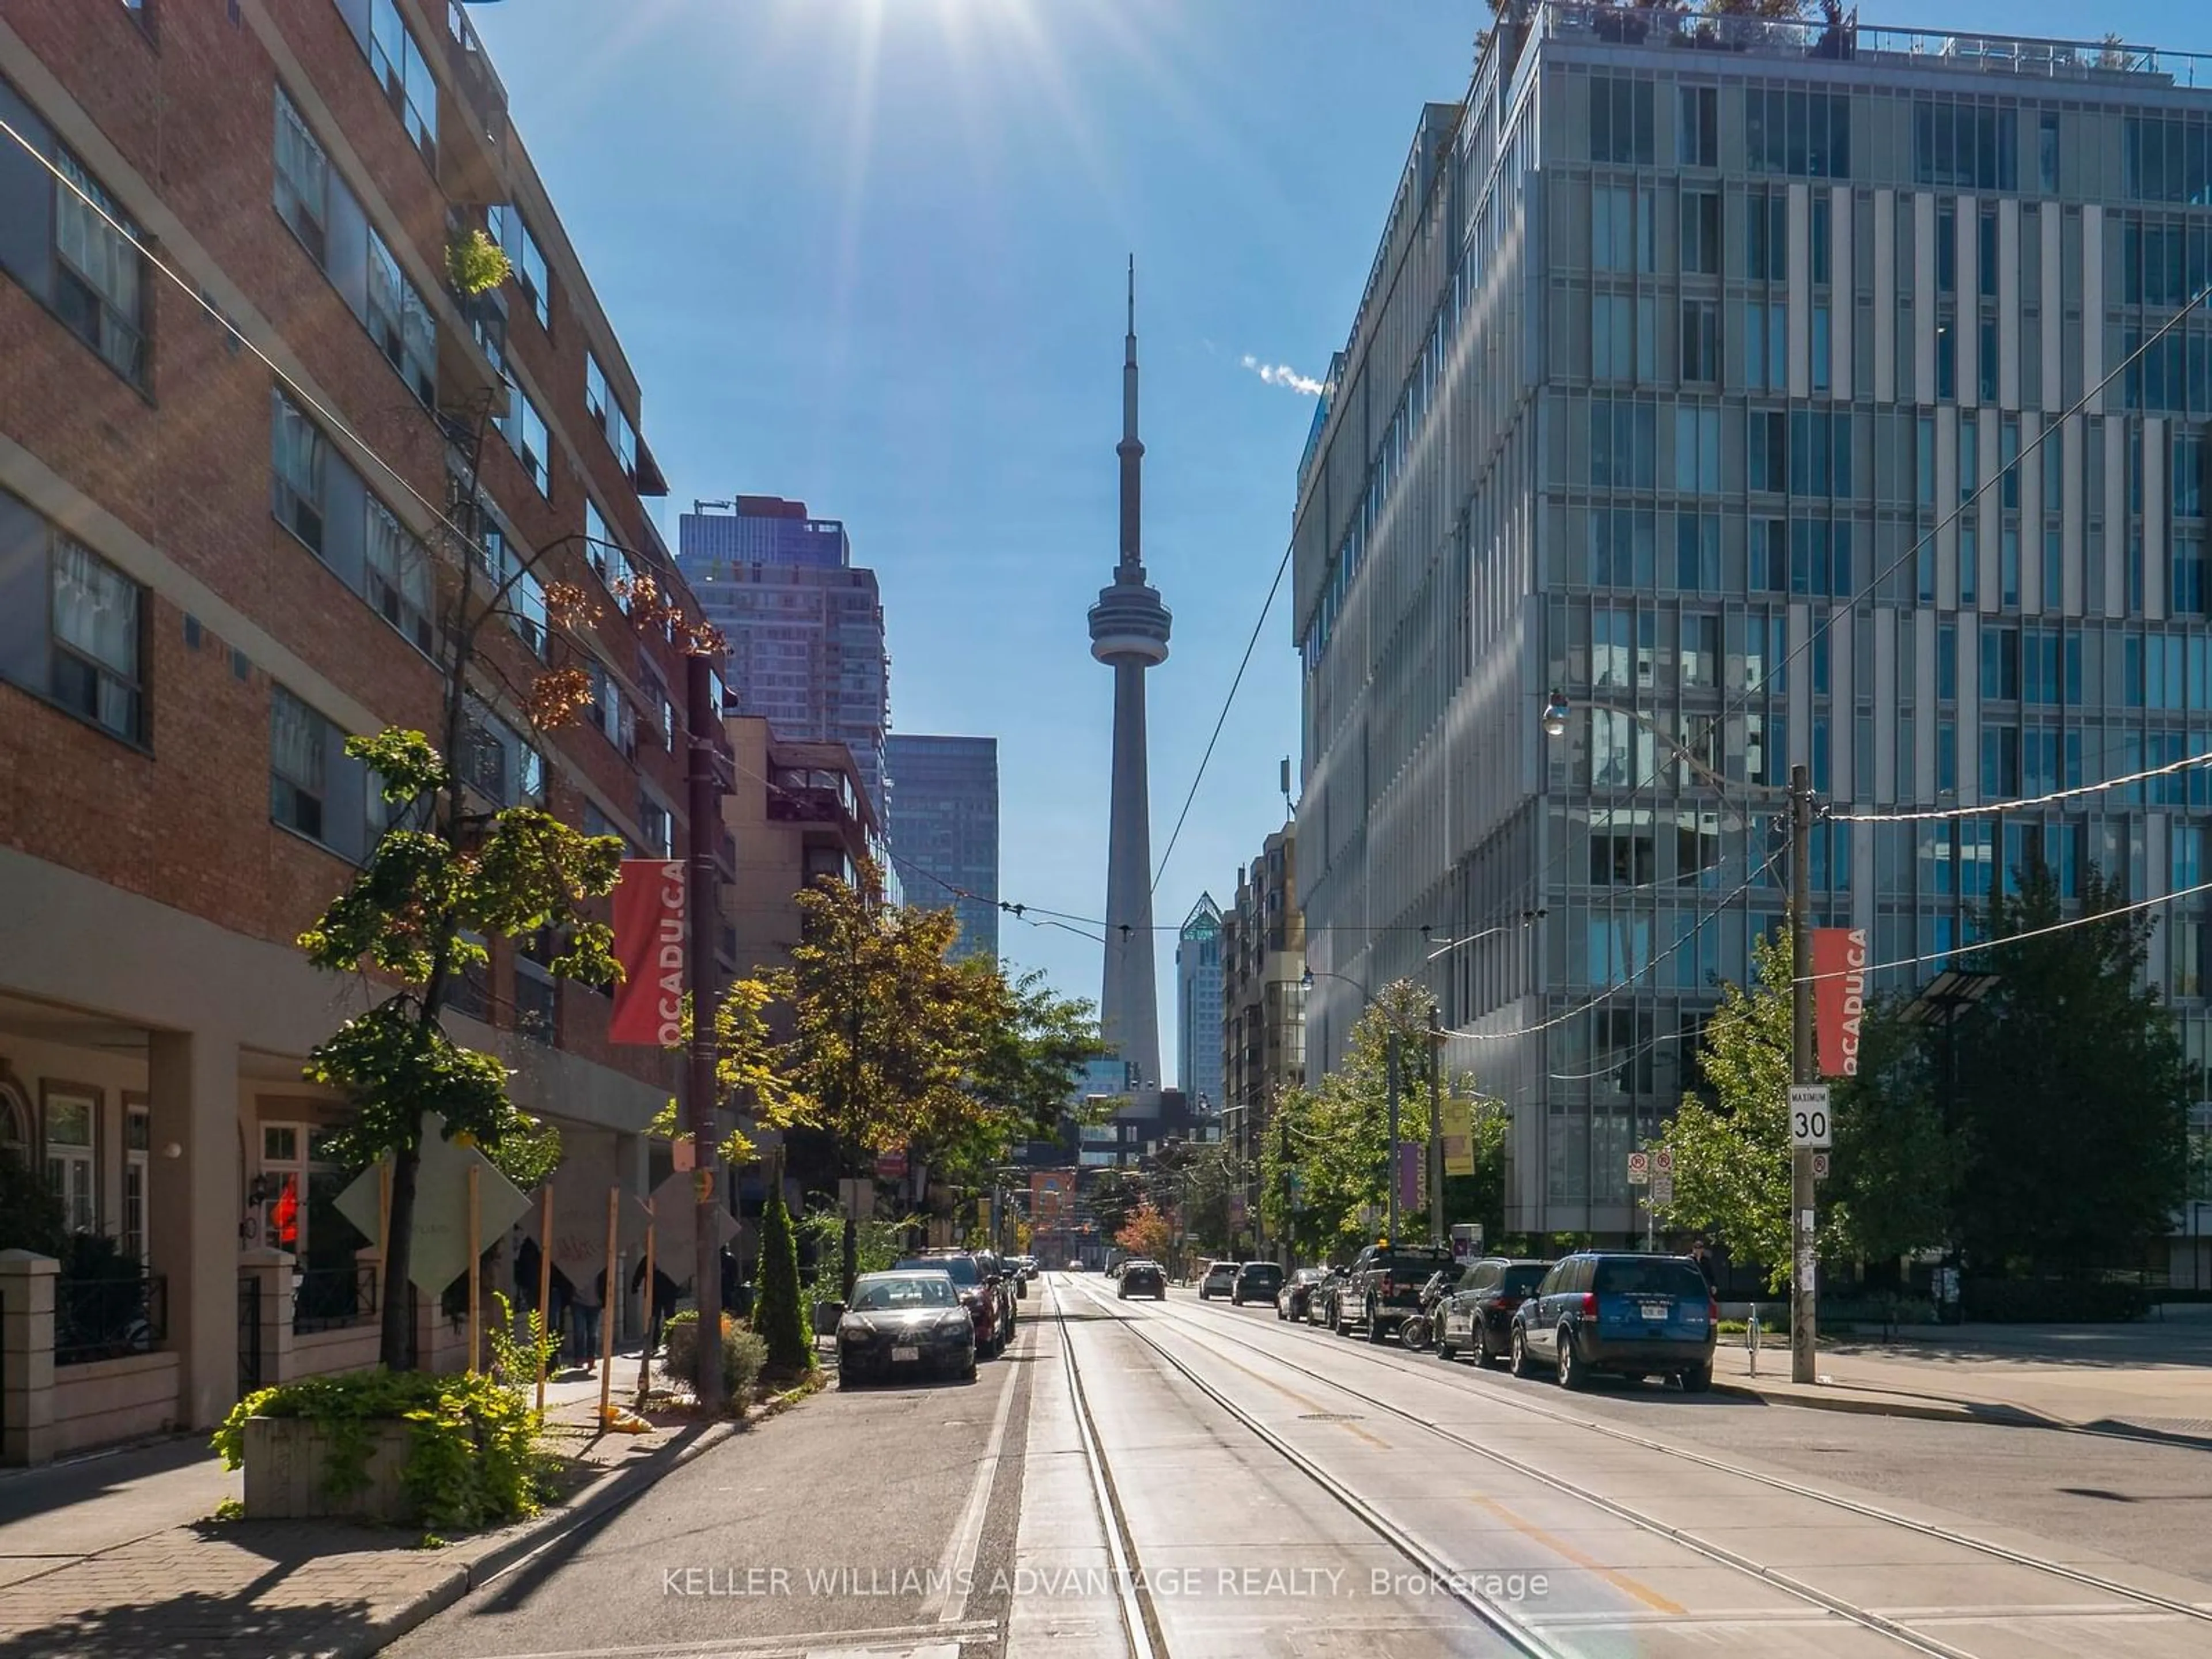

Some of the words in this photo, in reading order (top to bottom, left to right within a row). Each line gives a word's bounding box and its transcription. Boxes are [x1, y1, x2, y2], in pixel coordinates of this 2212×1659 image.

[658, 862, 685, 1048] OCADU.CA
[1792, 1093, 1825, 1101] MAXIMUM
[1795, 1112, 1825, 1138] 30
